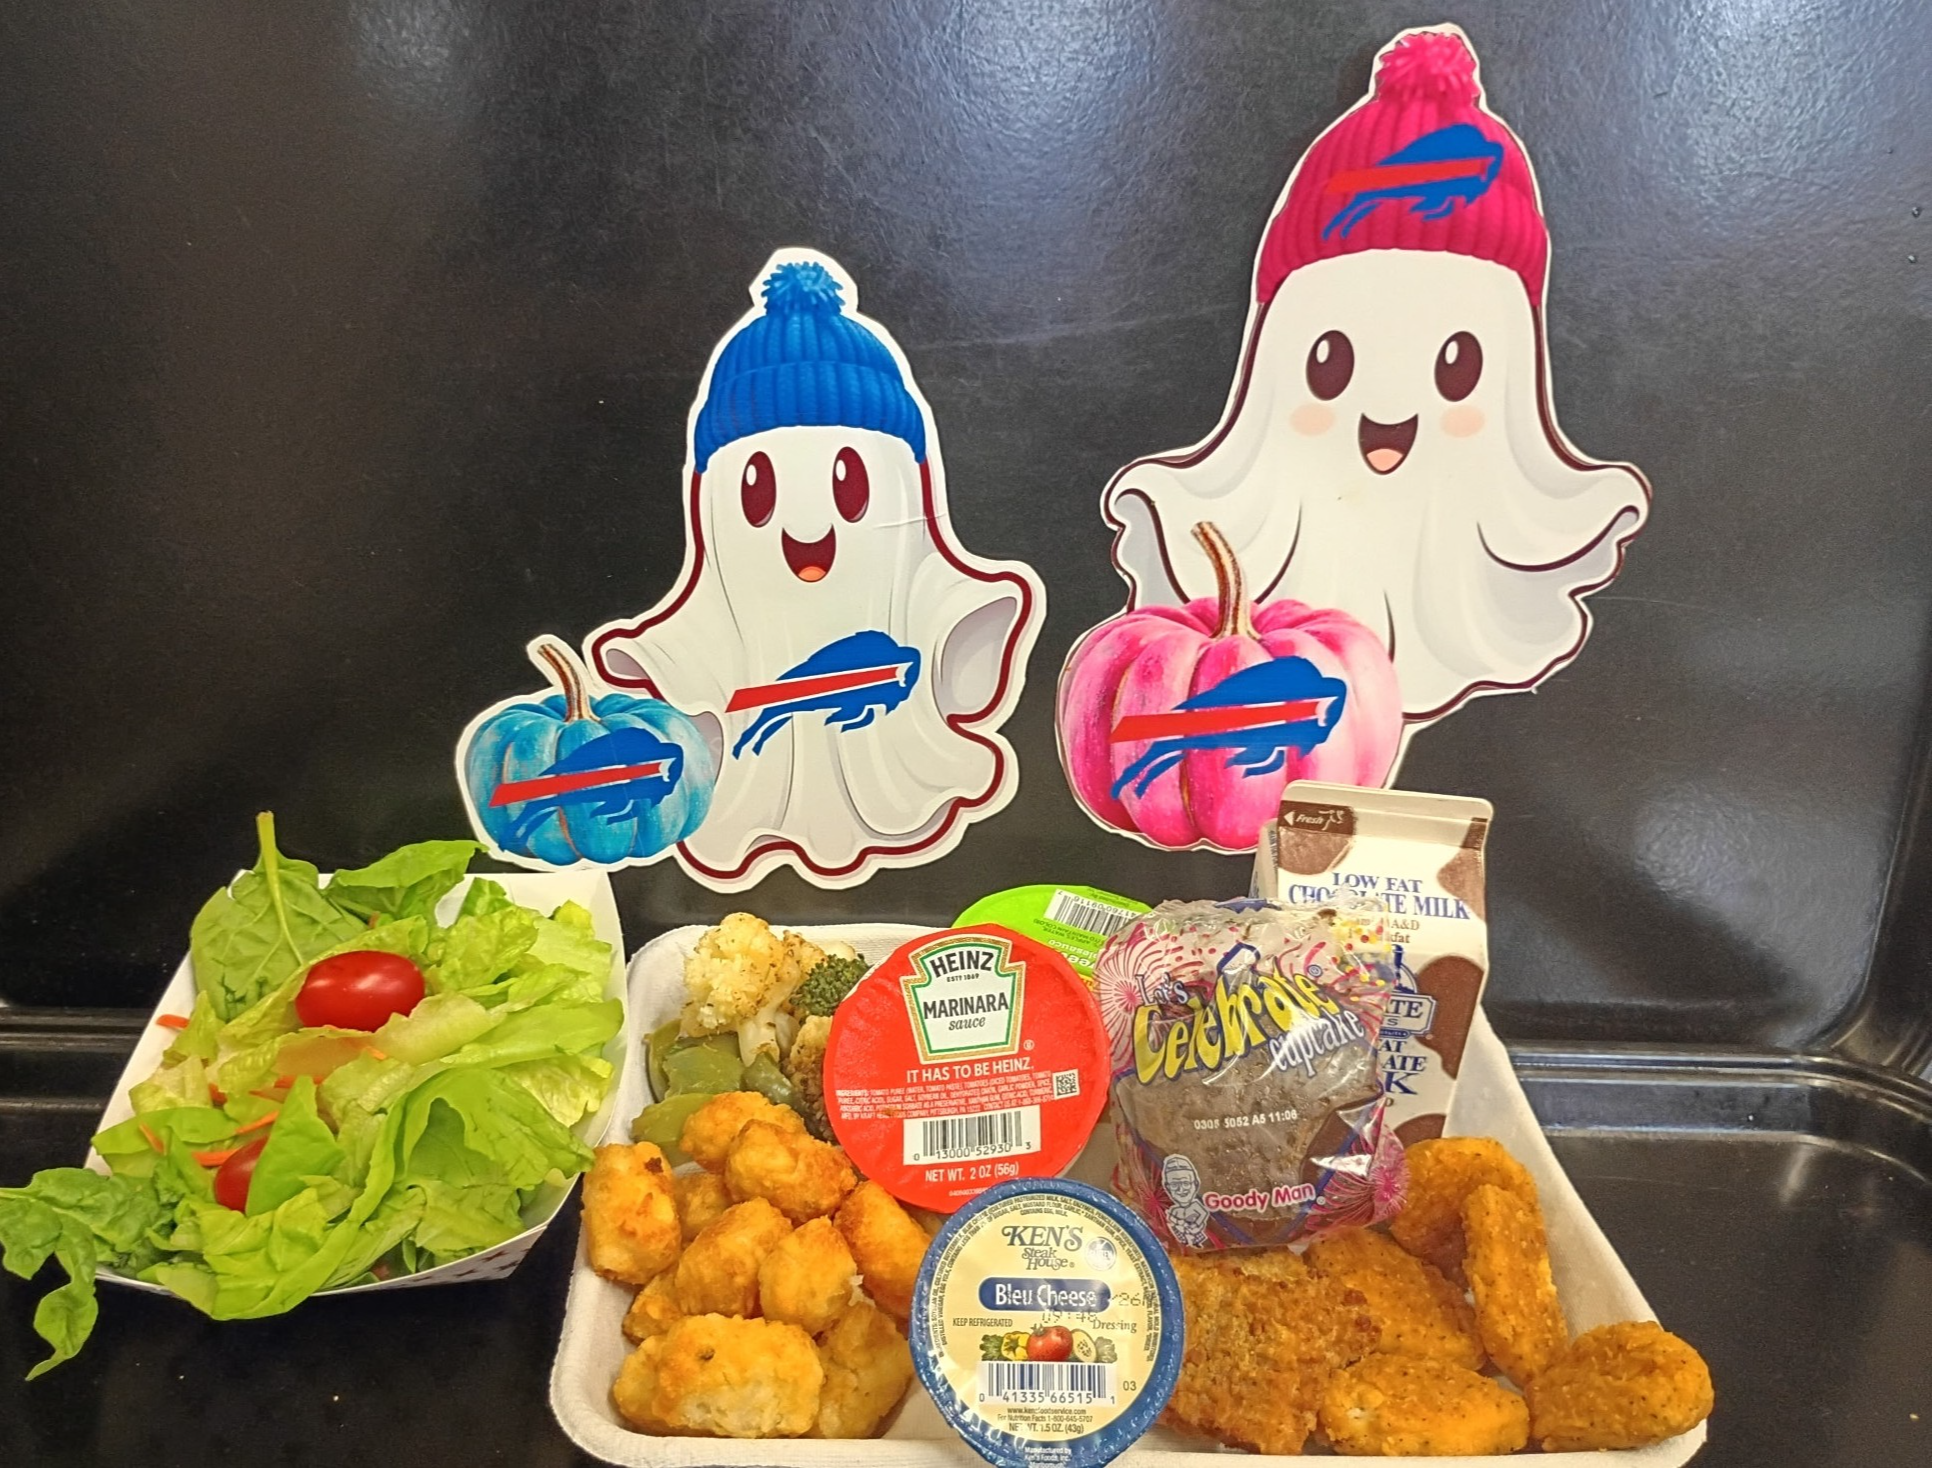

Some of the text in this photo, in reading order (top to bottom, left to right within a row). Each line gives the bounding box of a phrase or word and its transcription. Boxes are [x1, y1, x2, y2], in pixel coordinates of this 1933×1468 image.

[1296, 814, 1324, 824] Fresh
[1332, 872, 1423, 893] LOW FAT
[1289, 884, 1408, 914] CHOTE
[1413, 894, 1471, 920] MILK
[1391, 920, 1420, 930] A&D
[930, 949, 994, 978] HEINZ
[1135, 972, 1189, 1006] Let's
[923, 992, 1009, 1020] MARINARA
[948, 1017, 986, 1031] sauce
[1132, 956, 1341, 1085] Celebrate
[1268, 1007, 1366, 1078] cupcake
[906, 1070, 919, 1083] IT
[922, 1067, 950, 1082] HAS
[953, 1064, 972, 1079] TO
[974, 1062, 990, 1076] BE
[992, 1056, 1034, 1074] HEINZ.
[1252, 1113, 1266, 1125] A5
[913, 1141, 1032, 1162] 0 13000 52930 3
[925, 1161, 1019, 1182] NET WT. 2 OZ (56g)
[1203, 1184, 1315, 1213] Goody Man
[1001, 1225, 1084, 1252] KEN'S
[1021, 1247, 1058, 1260] Steak
[1025, 1257, 1069, 1271] House
[995, 1282, 1097, 1307] Bleu Cheese
[952, 1317, 1013, 1328] KEEP REFRIGERATED
[1122, 1380, 1138, 1392] 03
[979, 1391, 1116, 1405] 0 41335 66515 1
[1008, 1414, 1031, 1422] Nutrition
[1008, 1423, 1023, 1432] NE
[1064, 1423, 1085, 1434] (43g)
